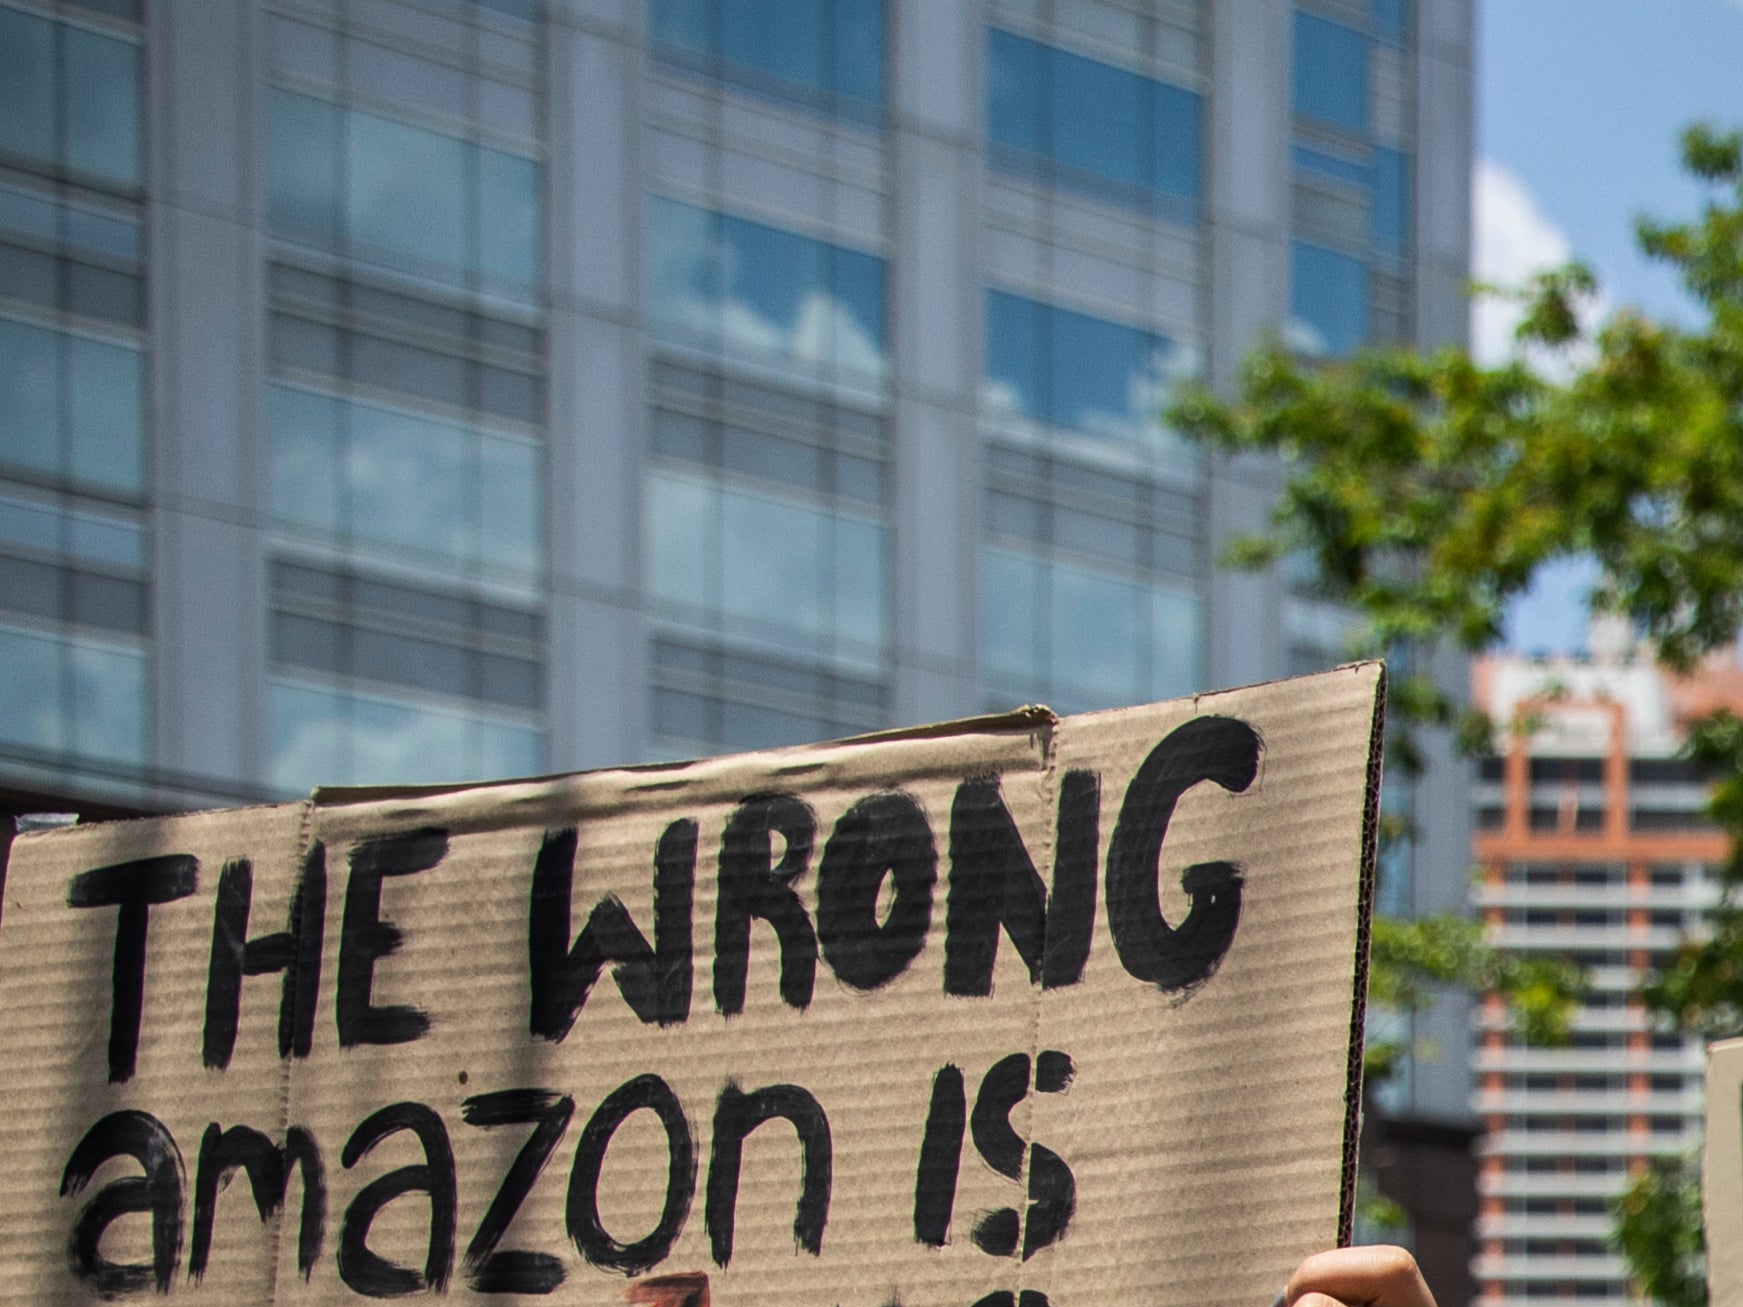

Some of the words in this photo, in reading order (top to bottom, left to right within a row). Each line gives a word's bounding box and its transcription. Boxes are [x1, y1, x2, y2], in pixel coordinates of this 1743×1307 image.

[67, 827, 450, 1083] THE
[527, 714, 1265, 1042] WRONG
[60, 1074, 832, 1300] amazon
[914, 1050, 1077, 1260] IS
